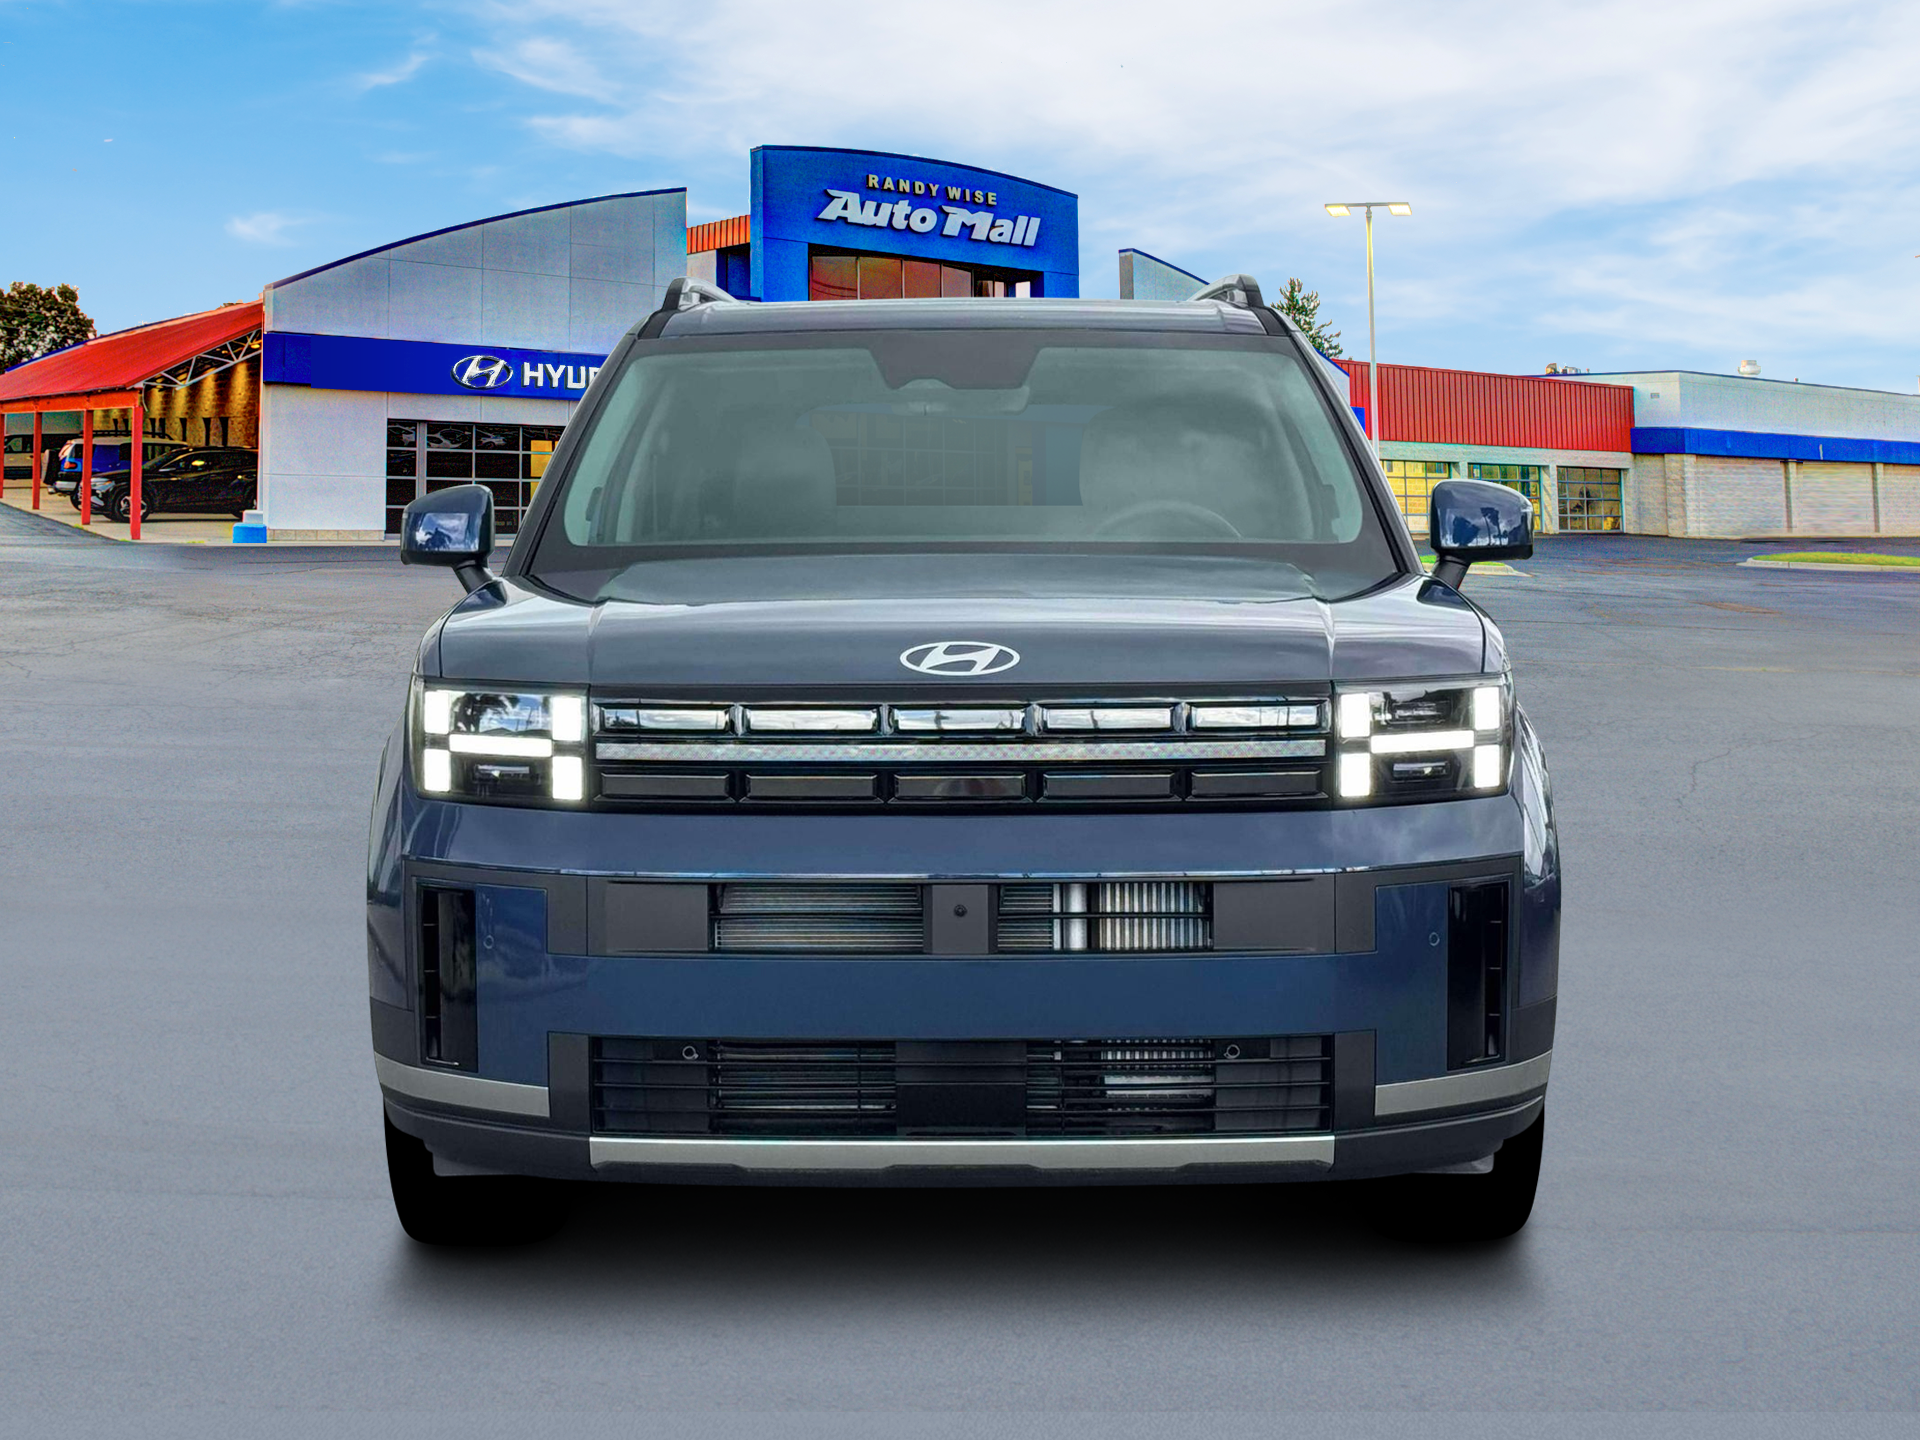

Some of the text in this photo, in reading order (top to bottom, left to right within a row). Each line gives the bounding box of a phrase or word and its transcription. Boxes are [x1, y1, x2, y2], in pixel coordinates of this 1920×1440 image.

[866, 173, 998, 206] RANDY WISE
[816, 188, 1042, 247] Auto Mall
